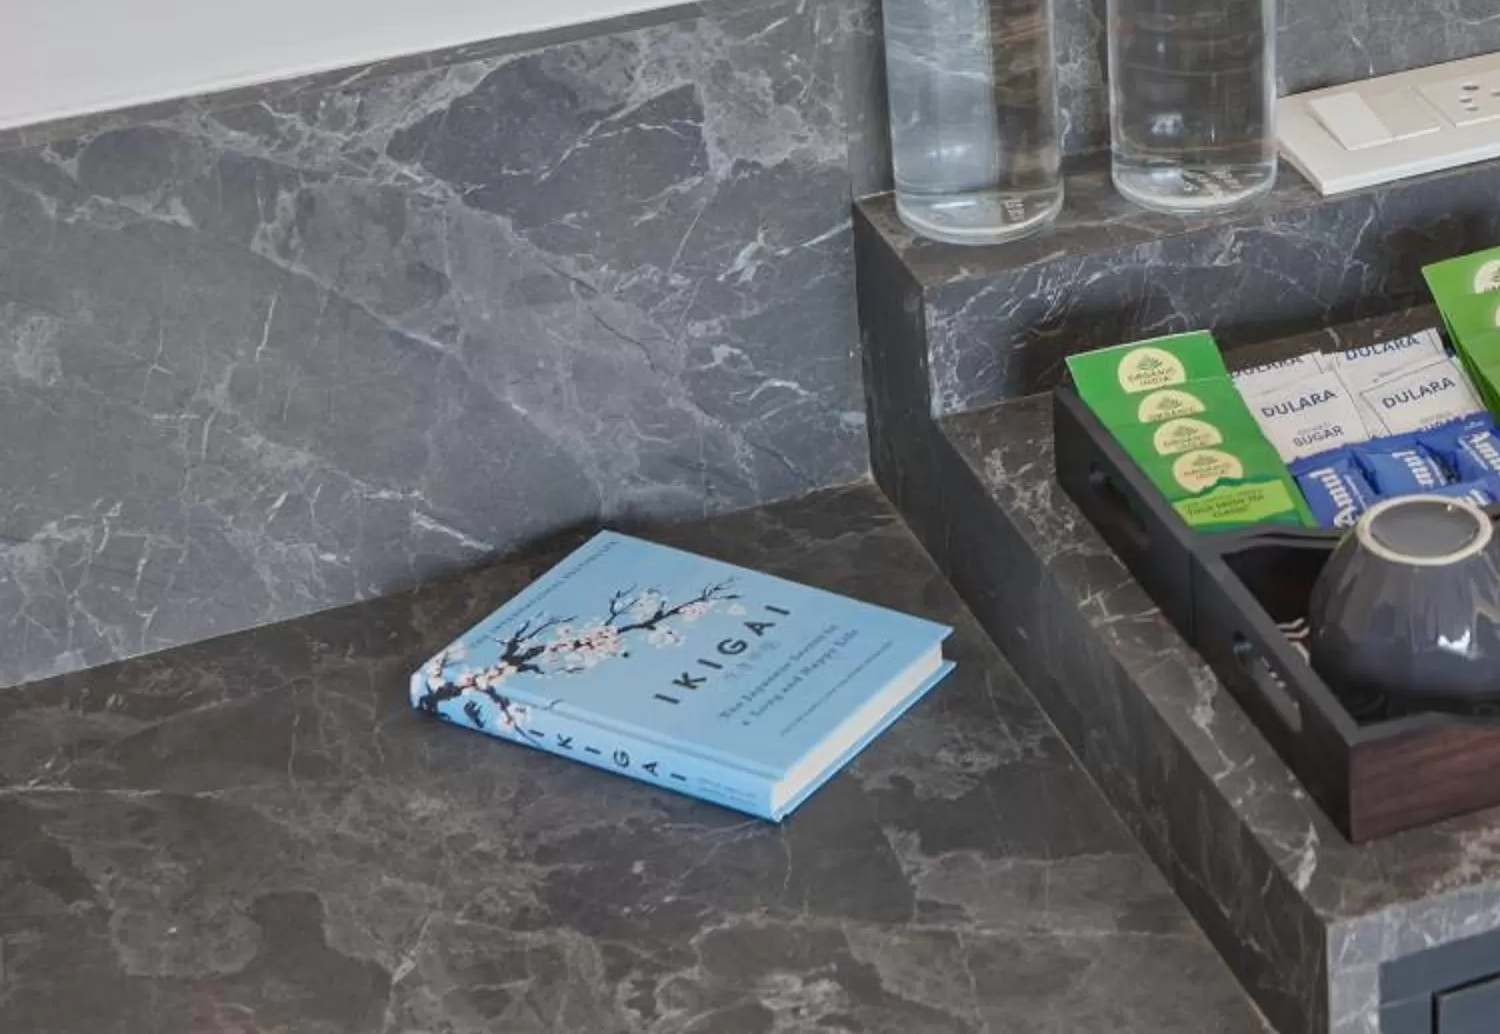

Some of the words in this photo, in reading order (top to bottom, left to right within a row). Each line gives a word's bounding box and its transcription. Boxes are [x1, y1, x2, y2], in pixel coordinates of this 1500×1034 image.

[1261, 389, 1339, 418] DULARA
[1381, 377, 1457, 409] DULARA
[1292, 424, 1345, 448] SUGAR
[1308, 467, 1358, 529] Amul
[653, 605, 790, 705] IKIGAI
[529, 729, 686, 782] IKIGAI
